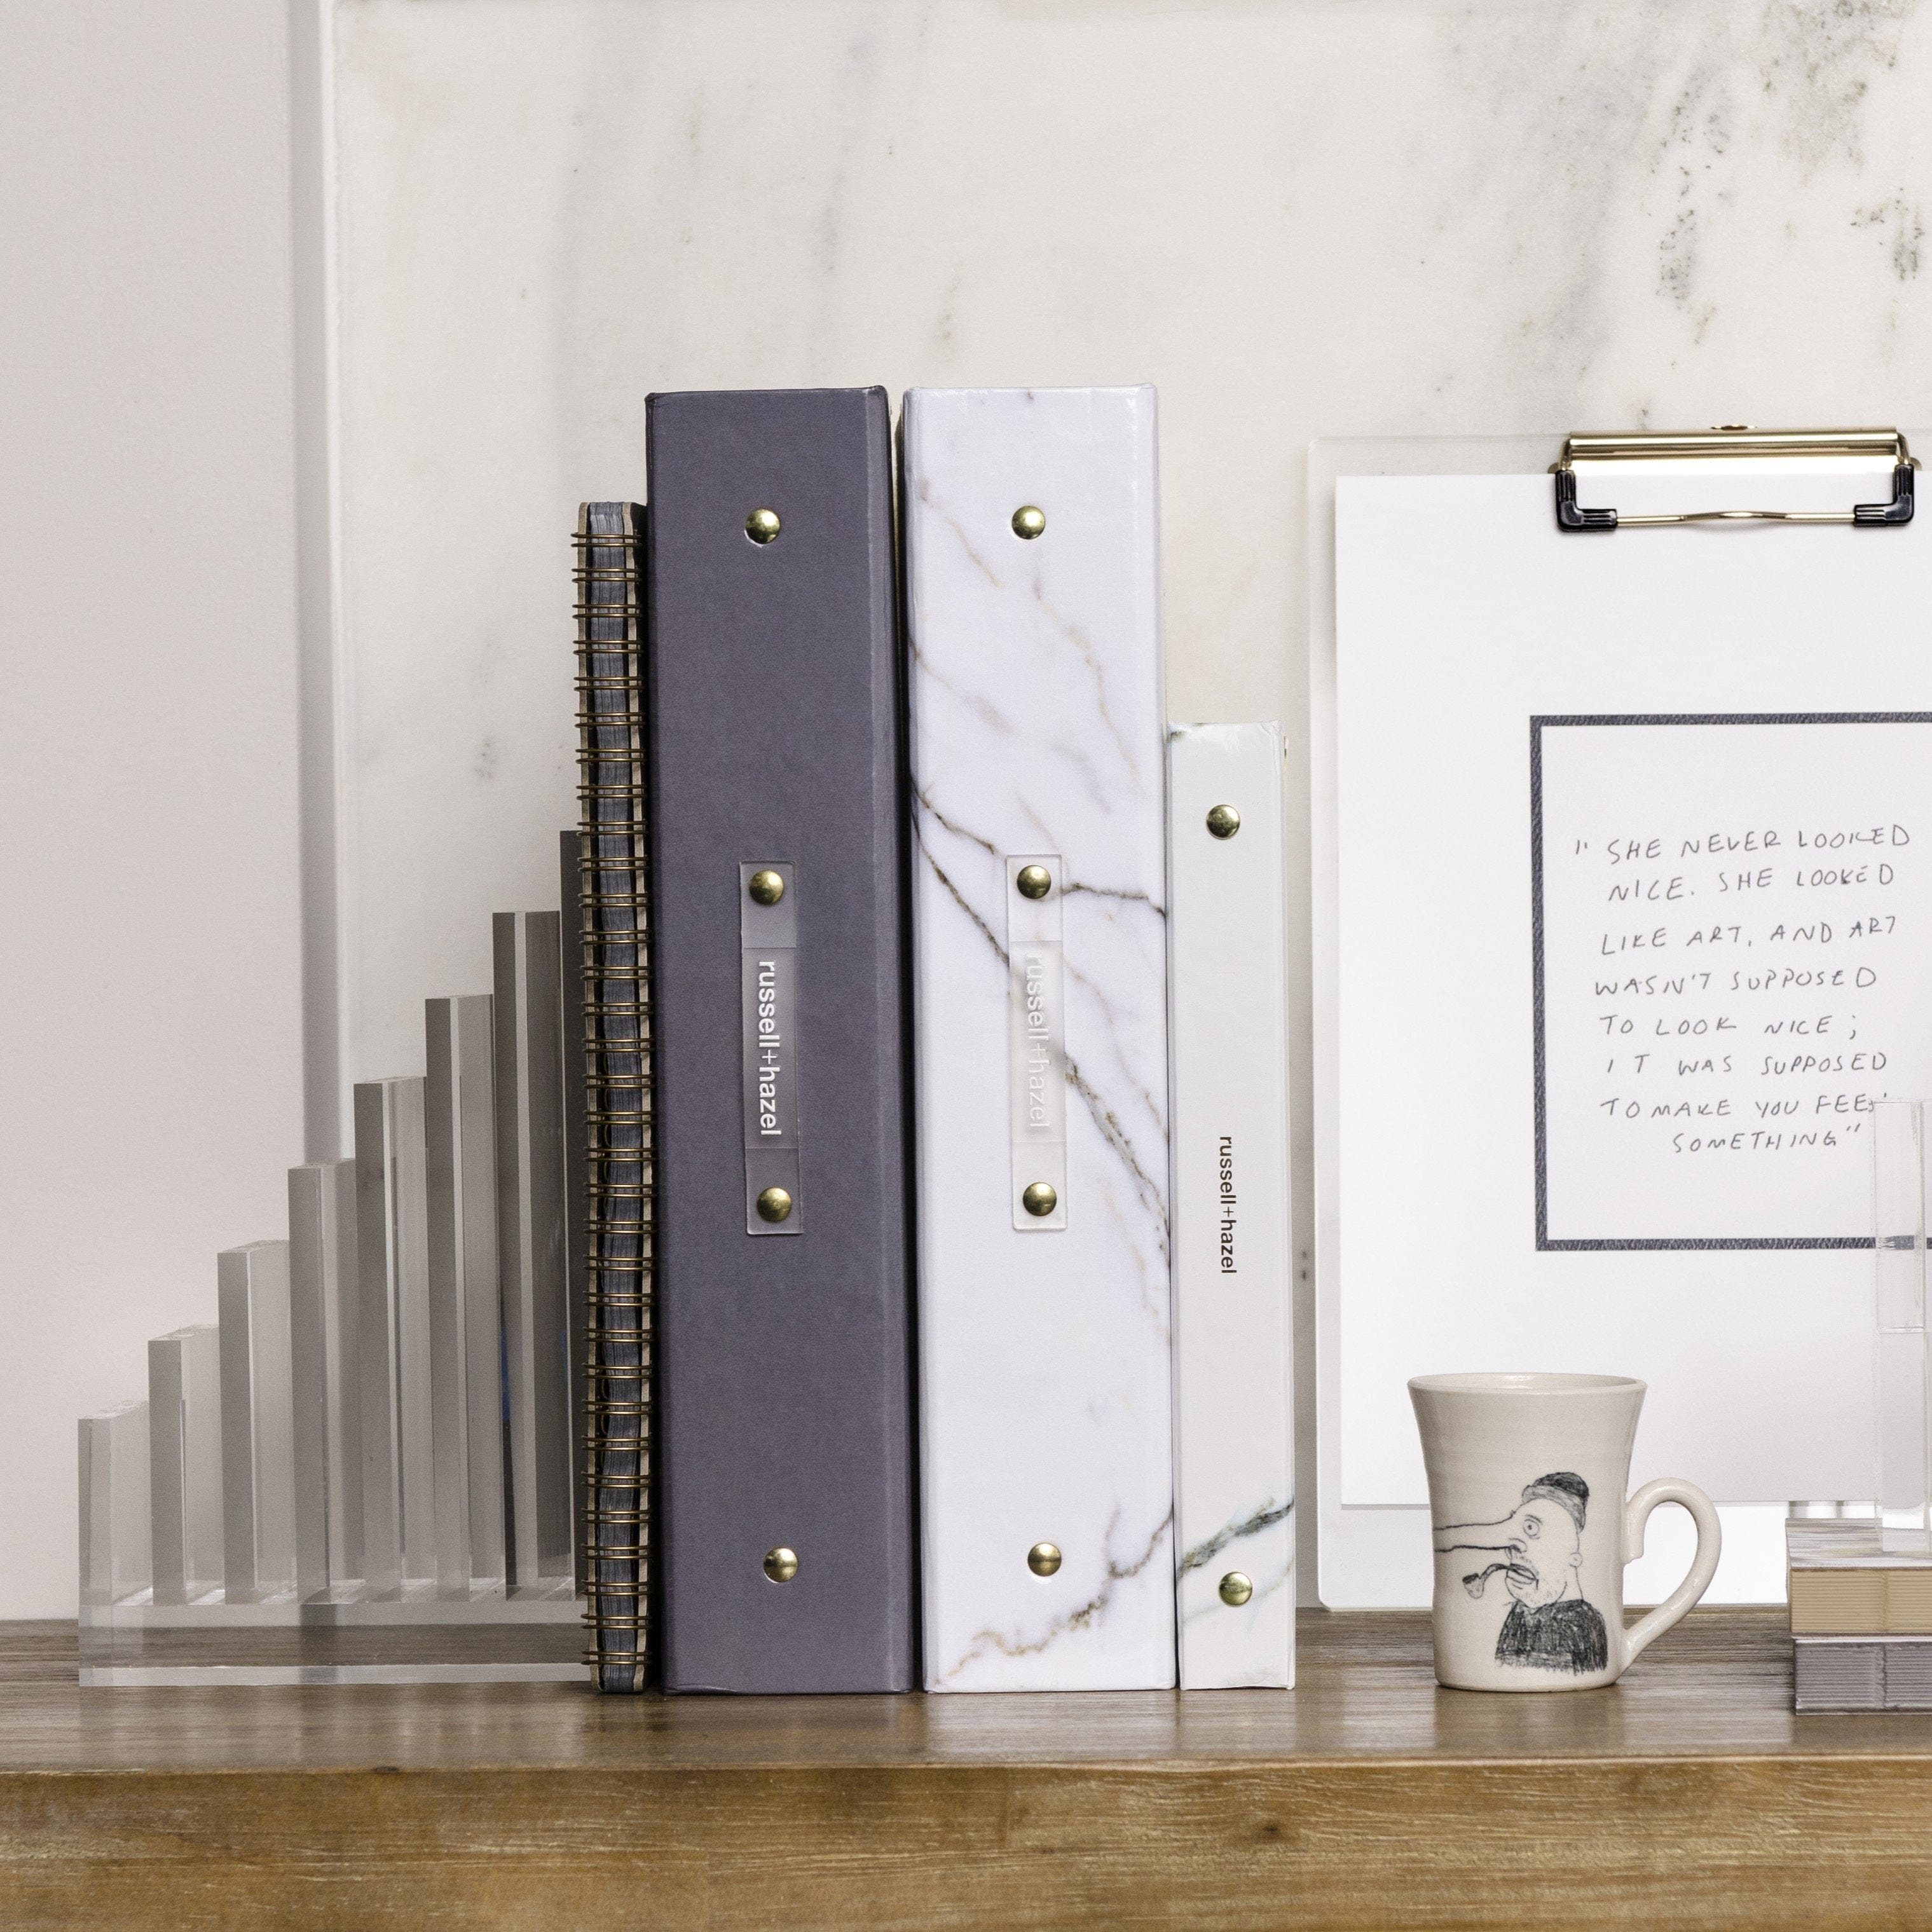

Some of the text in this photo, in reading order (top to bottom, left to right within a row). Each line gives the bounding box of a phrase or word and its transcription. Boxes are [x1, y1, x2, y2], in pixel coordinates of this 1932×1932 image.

[1680, 830, 1781, 858] NEVER
[1798, 824, 1910, 849] LOOKED
[1608, 863, 1893, 901] NICE. SHE LOOKED
[1601, 915, 1896, 956] LIKE ART, AND ART
[1595, 967, 1877, 996] WASN'T SUPPOSED
[1026, 954, 1050, 1127] russell+hazel
[1600, 1015, 1634, 1035] TO
[1655, 1017, 1737, 1036] LOOK
[758, 961, 782, 1135] russell+hazel
[1607, 1052, 1887, 1076] IT WAS SUPPOSED
[1755, 1100, 1799, 1118] YOU
[1219, 1136, 1237, 1273] russell+hazel
